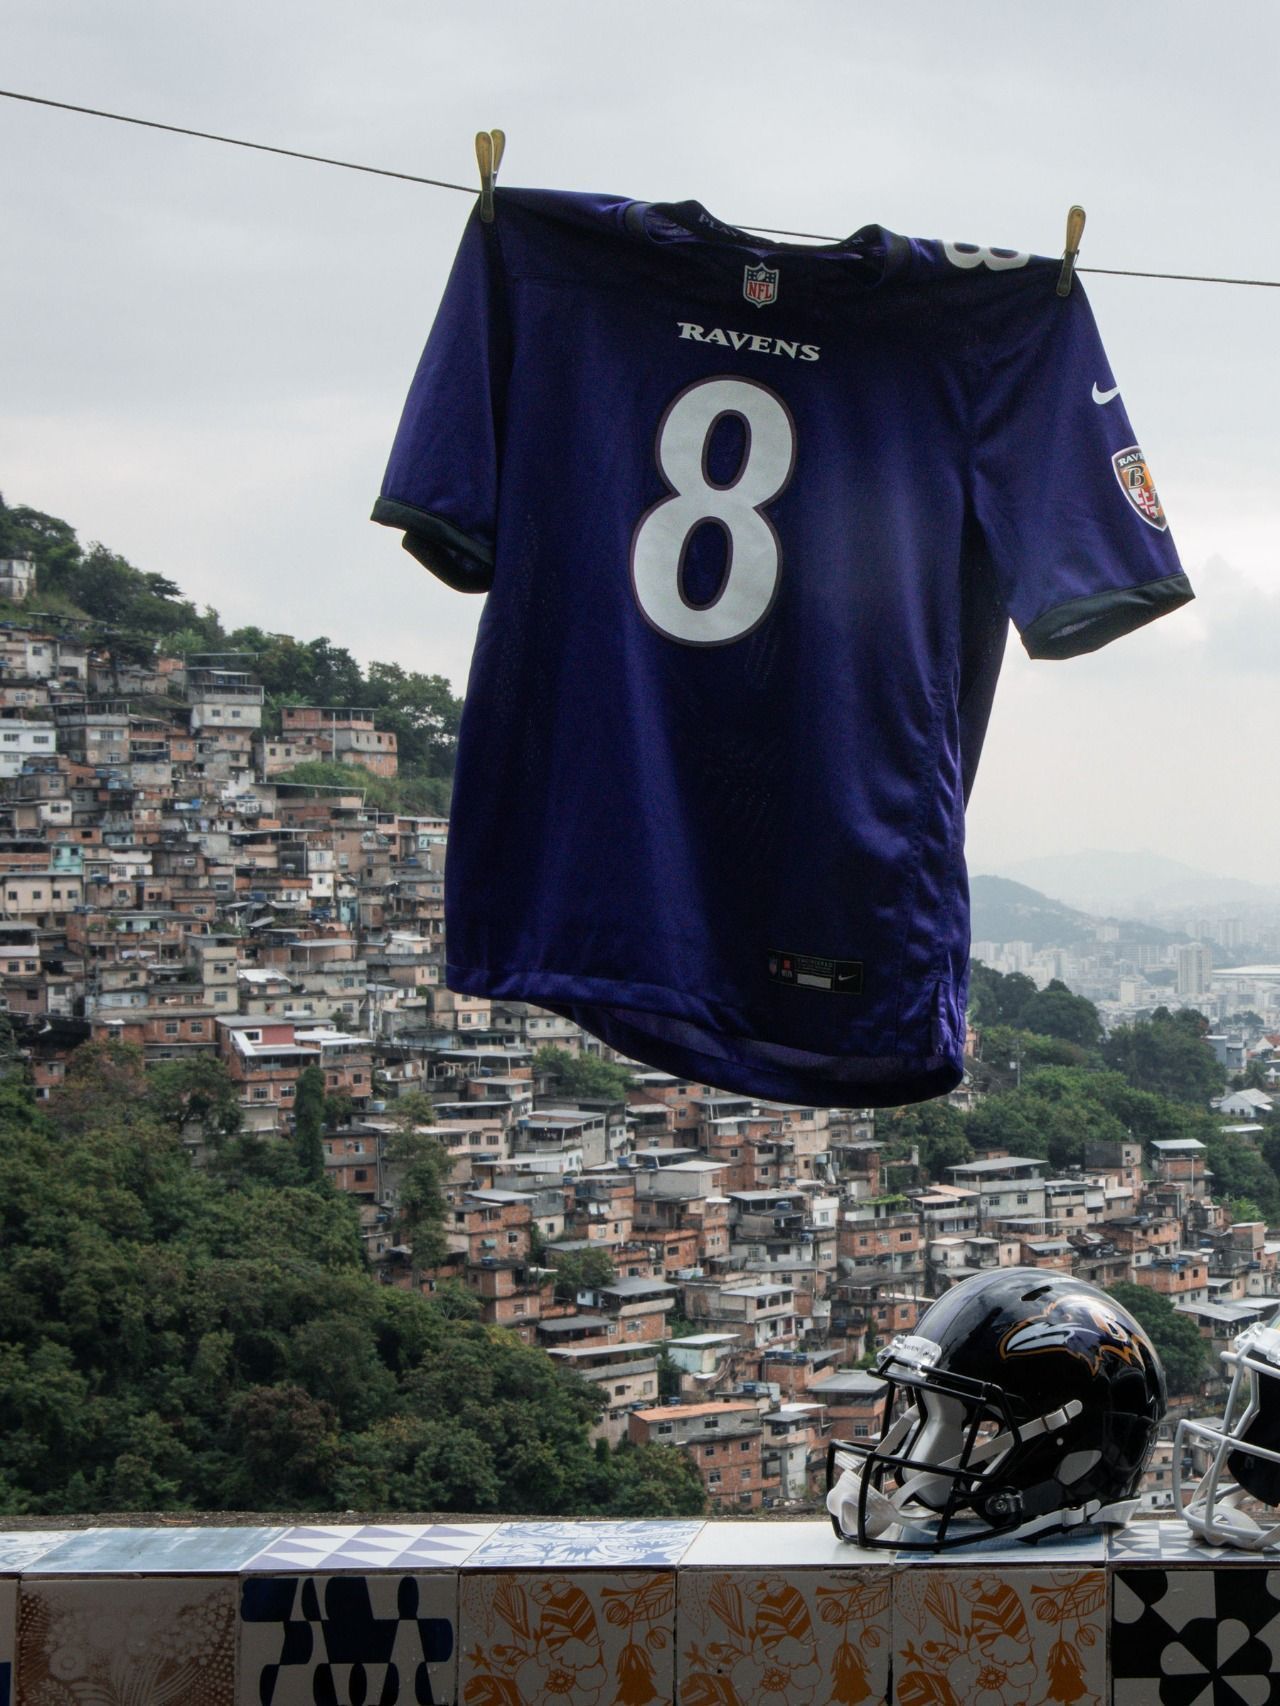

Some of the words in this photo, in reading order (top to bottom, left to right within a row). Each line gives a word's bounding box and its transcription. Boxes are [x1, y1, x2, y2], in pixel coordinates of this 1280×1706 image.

[749, 282, 773, 300] NFL
[676, 321, 822, 362] RAVENS
[629, 374, 797, 648] 8
